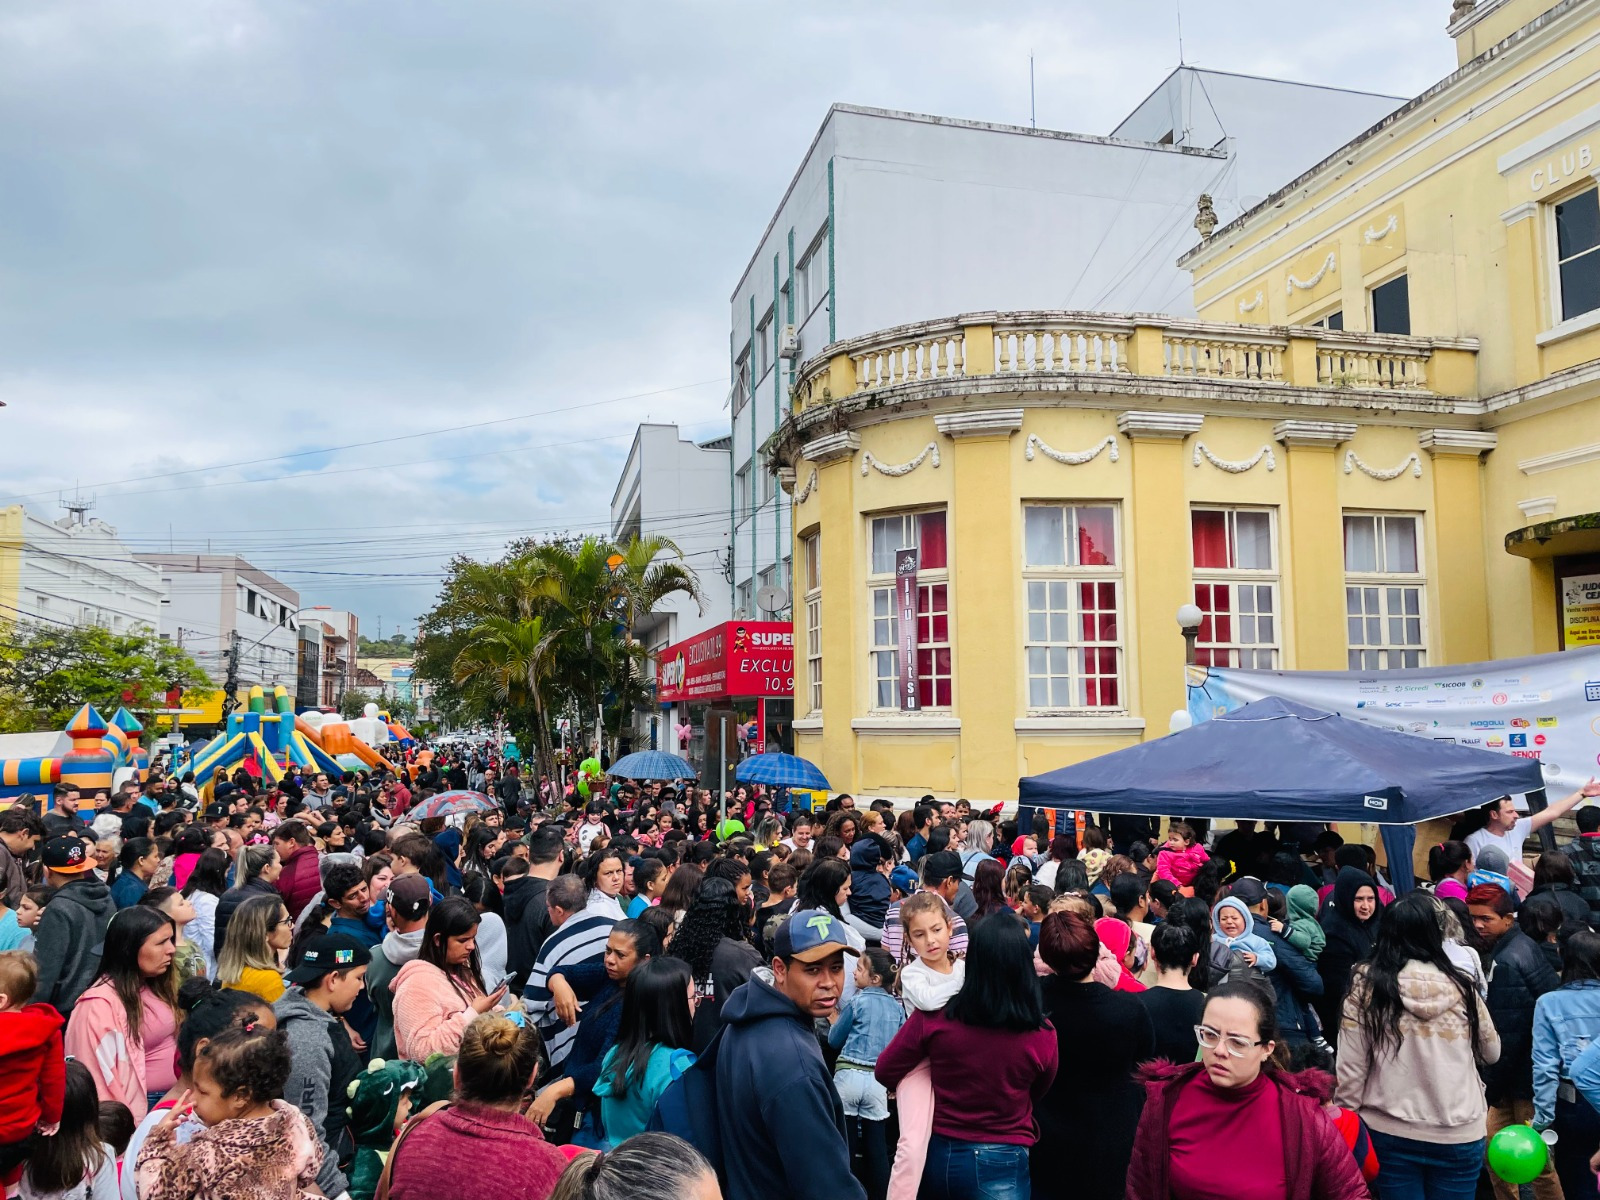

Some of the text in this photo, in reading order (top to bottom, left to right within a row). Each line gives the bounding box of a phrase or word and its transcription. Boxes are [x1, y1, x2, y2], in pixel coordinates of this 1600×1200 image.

[1530, 144, 1593, 192] CLUB
[1511, 718, 1530, 728] Clip
[1511, 750, 1542, 759] BENOIT
